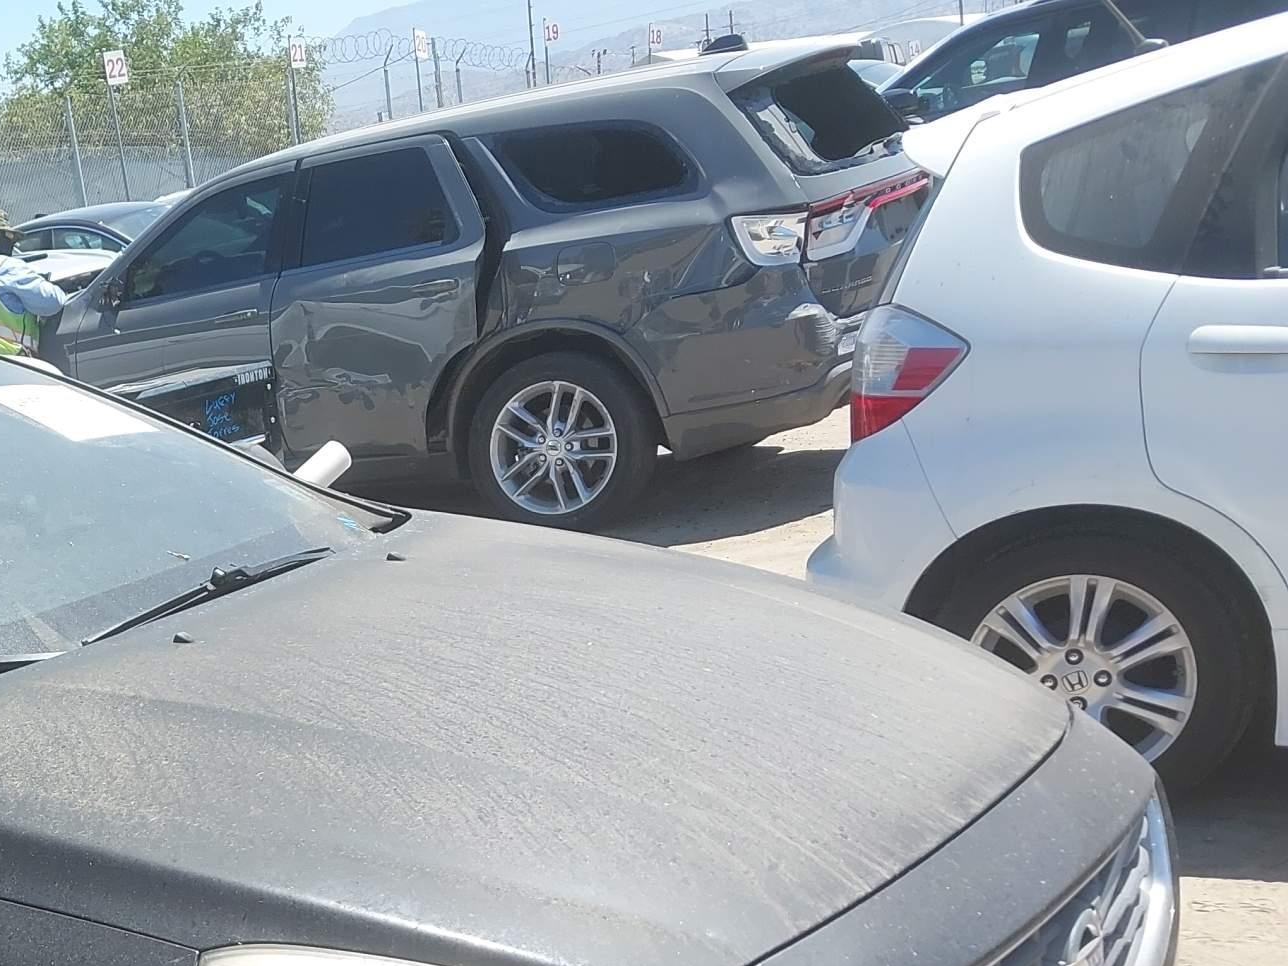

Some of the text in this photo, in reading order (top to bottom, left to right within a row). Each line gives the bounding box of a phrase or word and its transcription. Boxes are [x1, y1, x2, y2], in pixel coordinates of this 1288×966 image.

[546, 23, 559, 41] 19
[650, 29, 662, 44] 18
[291, 43, 305, 63] 21
[106, 57, 126, 79] 22
[237, 367, 269, 385] IRONTON
